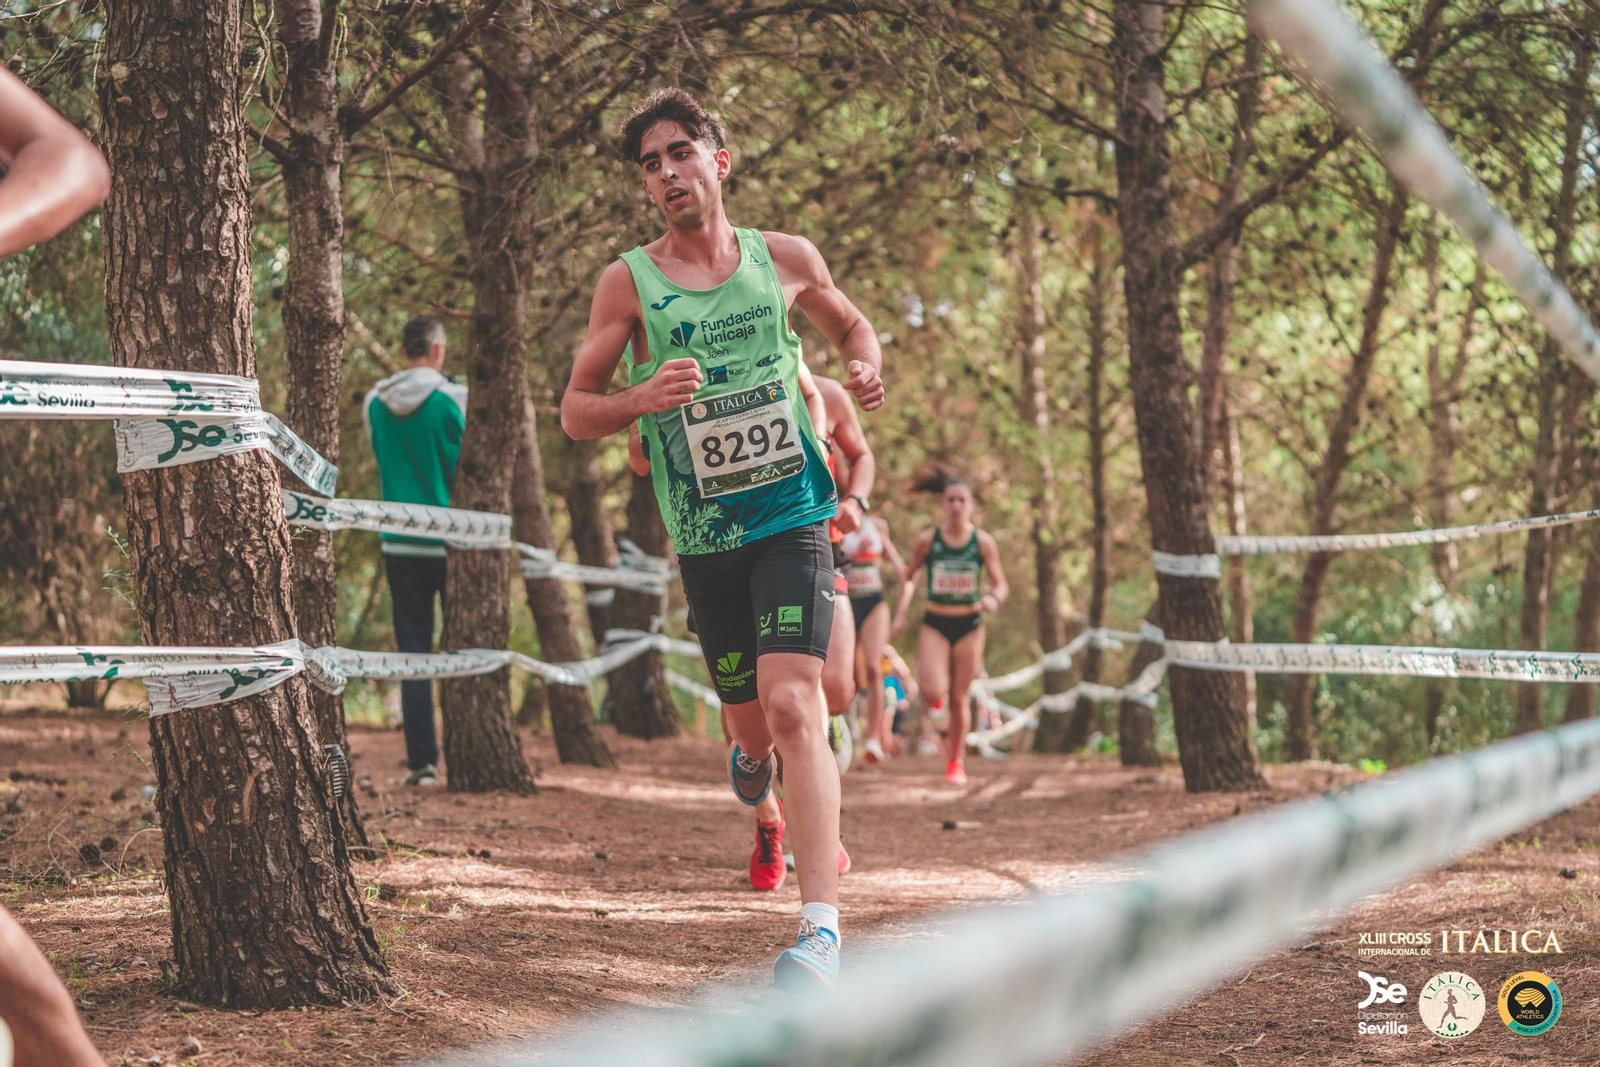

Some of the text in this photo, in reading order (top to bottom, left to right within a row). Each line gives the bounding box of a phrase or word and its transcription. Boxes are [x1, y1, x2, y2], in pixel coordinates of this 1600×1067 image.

[700, 304, 772, 333] Fundación
[703, 323, 756, 346] Unicaja
[706, 348, 730, 360] Jaén
[713, 390, 763, 413] ITÁLICA
[701, 417, 796, 468] 8292
[716, 669, 755, 682] Fundación
[717, 679, 746, 688] Unicaja
